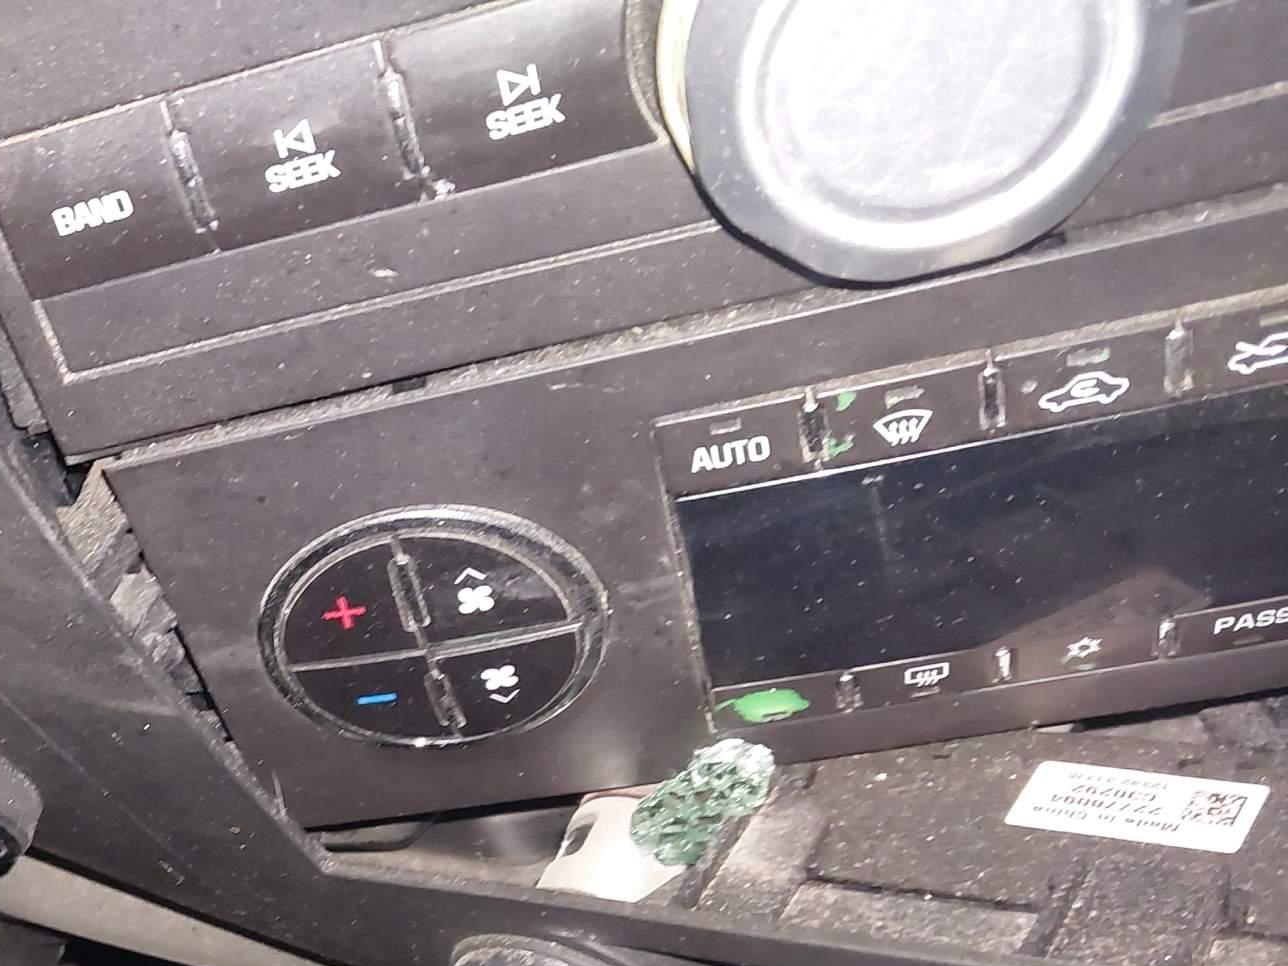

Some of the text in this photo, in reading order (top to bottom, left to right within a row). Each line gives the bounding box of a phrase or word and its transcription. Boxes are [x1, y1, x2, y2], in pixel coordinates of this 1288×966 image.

[485, 94, 566, 141] SEEK
[264, 149, 343, 193] SEEK
[51, 189, 134, 237] BAND
[690, 435, 771, 473] AUTO
